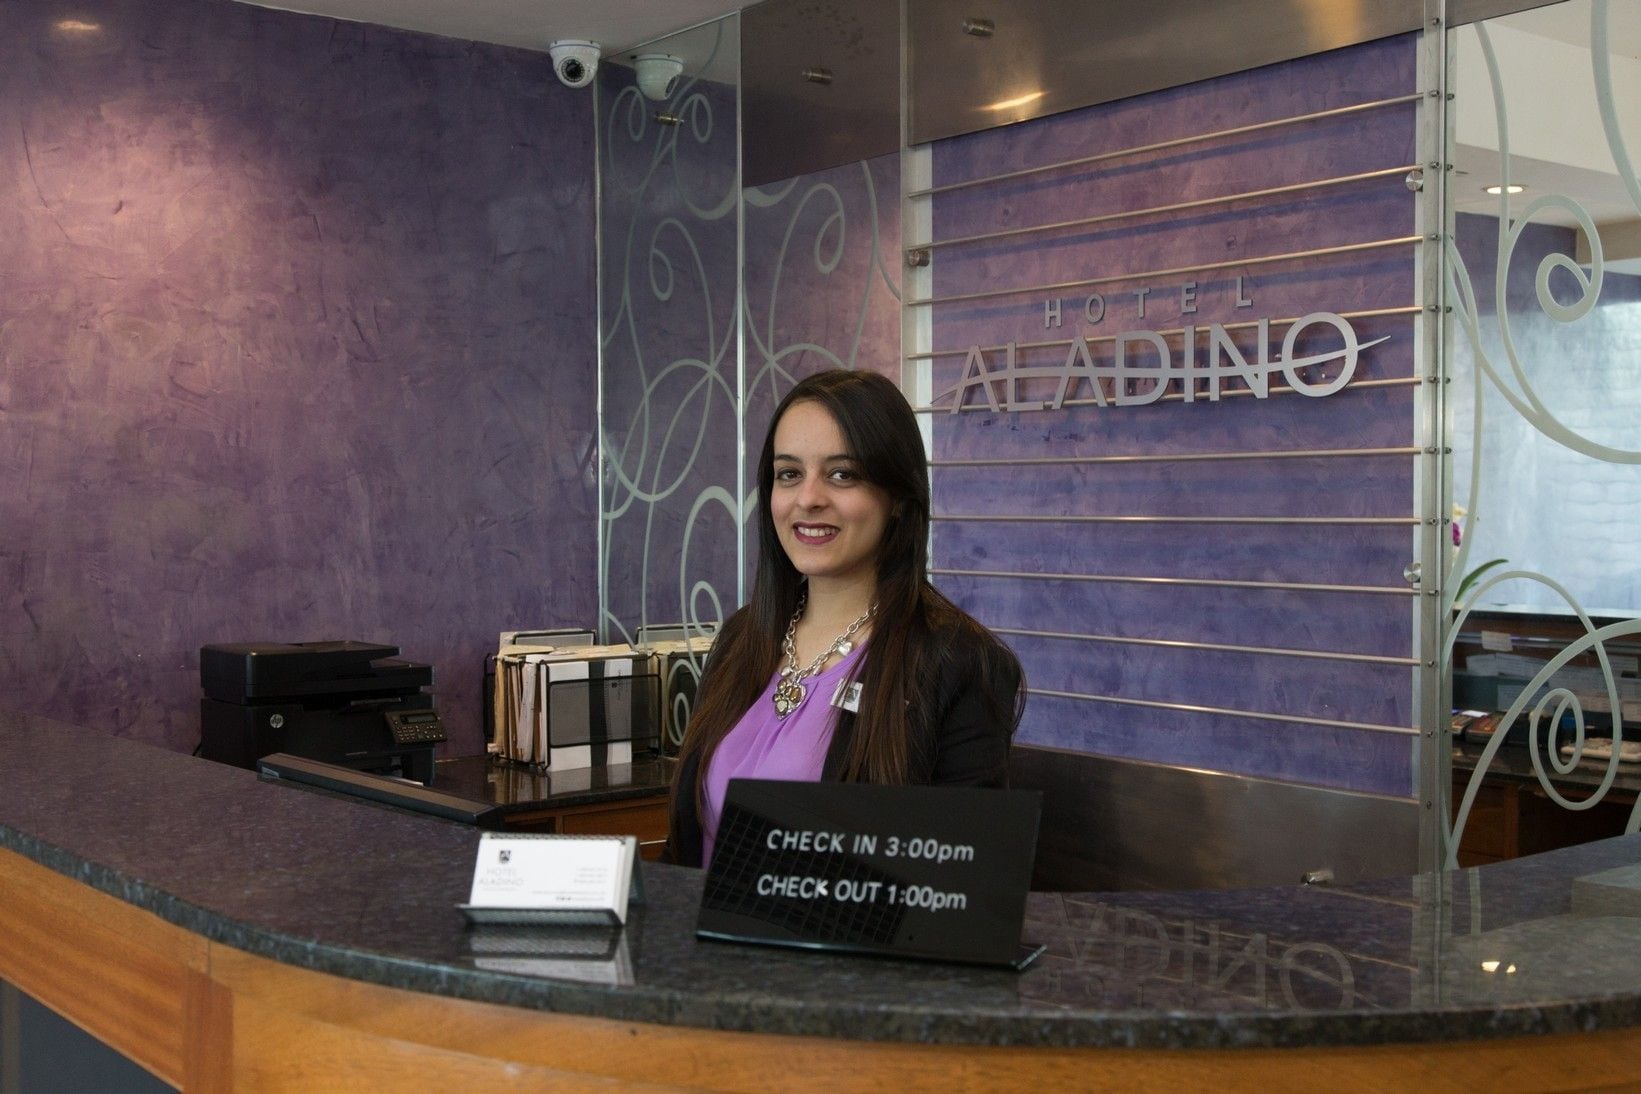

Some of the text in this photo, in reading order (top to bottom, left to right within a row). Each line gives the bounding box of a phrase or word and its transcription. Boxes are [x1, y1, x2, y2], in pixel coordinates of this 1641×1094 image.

[1044, 276, 1254, 328] HOTEL
[947, 311, 1362, 415] ALADINO
[766, 829, 975, 864] CHECK IN 3:00pm
[757, 874, 967, 912] CHECK OUT 1:00pm
